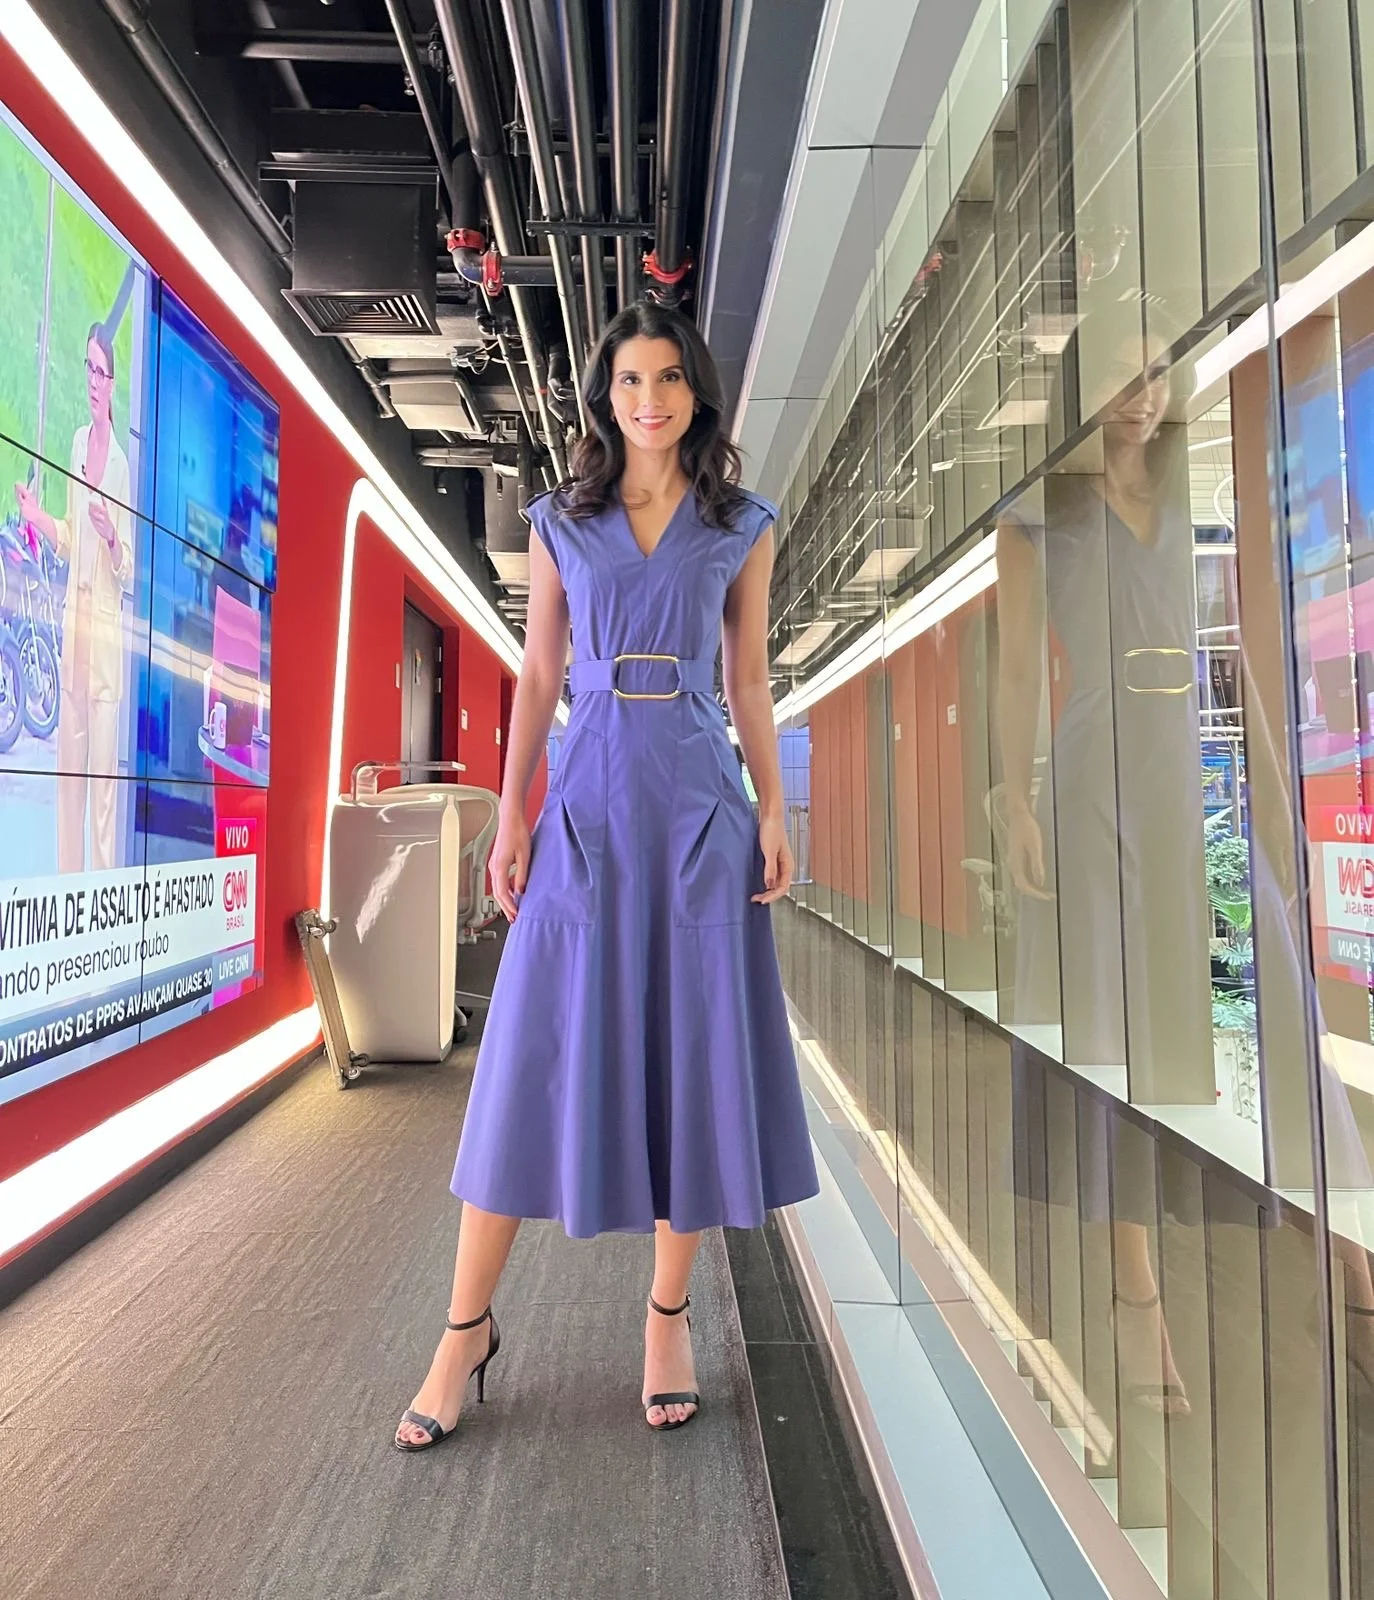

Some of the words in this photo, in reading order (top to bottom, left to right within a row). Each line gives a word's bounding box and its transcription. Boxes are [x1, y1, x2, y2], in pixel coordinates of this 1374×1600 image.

[225, 825, 249, 849] VIVO
[64, 890, 86, 938] DE
[89, 881, 150, 933] ASSALTO
[154, 870, 161, 919] É
[163, 872, 214, 917] AFASTADO
[222, 868, 248, 912] CNN
[226, 917, 245, 931] BRASIL
[46, 940, 130, 994] presenciou
[134, 931, 169, 963] roubo
[219, 957, 233, 981] LIVE
[235, 952, 249, 974] CNN
[76, 1009, 93, 1039] DE
[95, 998, 125, 1030] PPPS
[126, 980, 174, 1018] AVANÇAM
[175, 971, 203, 999] QUASE
[203, 966, 213, 988] 30
